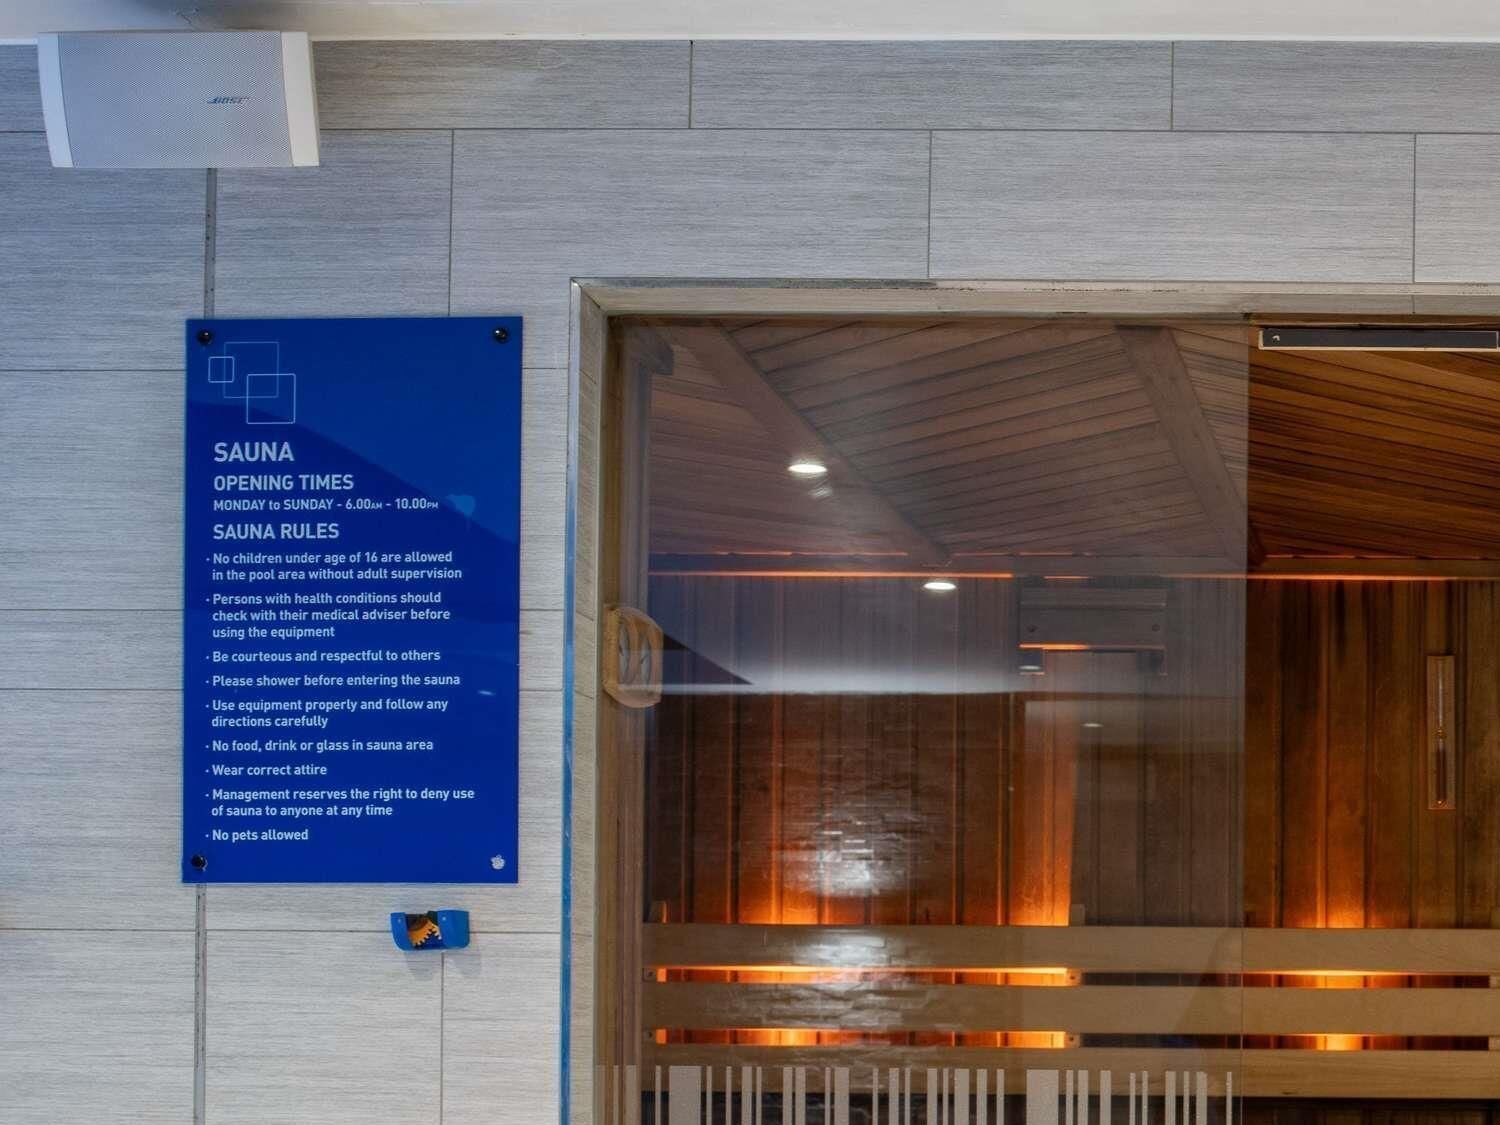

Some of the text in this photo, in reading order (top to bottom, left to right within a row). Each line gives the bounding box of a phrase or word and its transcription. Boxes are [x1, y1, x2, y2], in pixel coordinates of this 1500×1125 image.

[214, 442, 295, 462] SAUNA
[214, 474, 354, 491] OPENING TIMES
[213, 499, 266, 511] MONDAY
[269, 500, 282, 511] to
[283, 498, 334, 510] SUNDAY
[213, 522, 339, 540] SAUNA RULES
[213, 552, 452, 565] No children under age of 16 are allowed
[212, 568, 462, 583] in the pool area without adult supervision
[213, 592, 441, 605] Persons with health conditions should
[212, 608, 451, 621] check with their medical adviser before
[213, 626, 335, 640] using the equipment
[213, 649, 441, 664] Be courteous and respectful to others
[213, 672, 460, 688] Please shower before entering the sauna
[212, 698, 448, 713] Use equipment properly and follow any
[211, 714, 328, 728] directions carefully
[212, 739, 434, 753] No food, drink or glass in sauna area
[212, 763, 327, 776] Wear correct attire
[212, 788, 475, 803] Management reserves the right to deny use
[211, 804, 393, 818] of sauna to anyone at any time
[212, 829, 309, 843] No pets allowed
